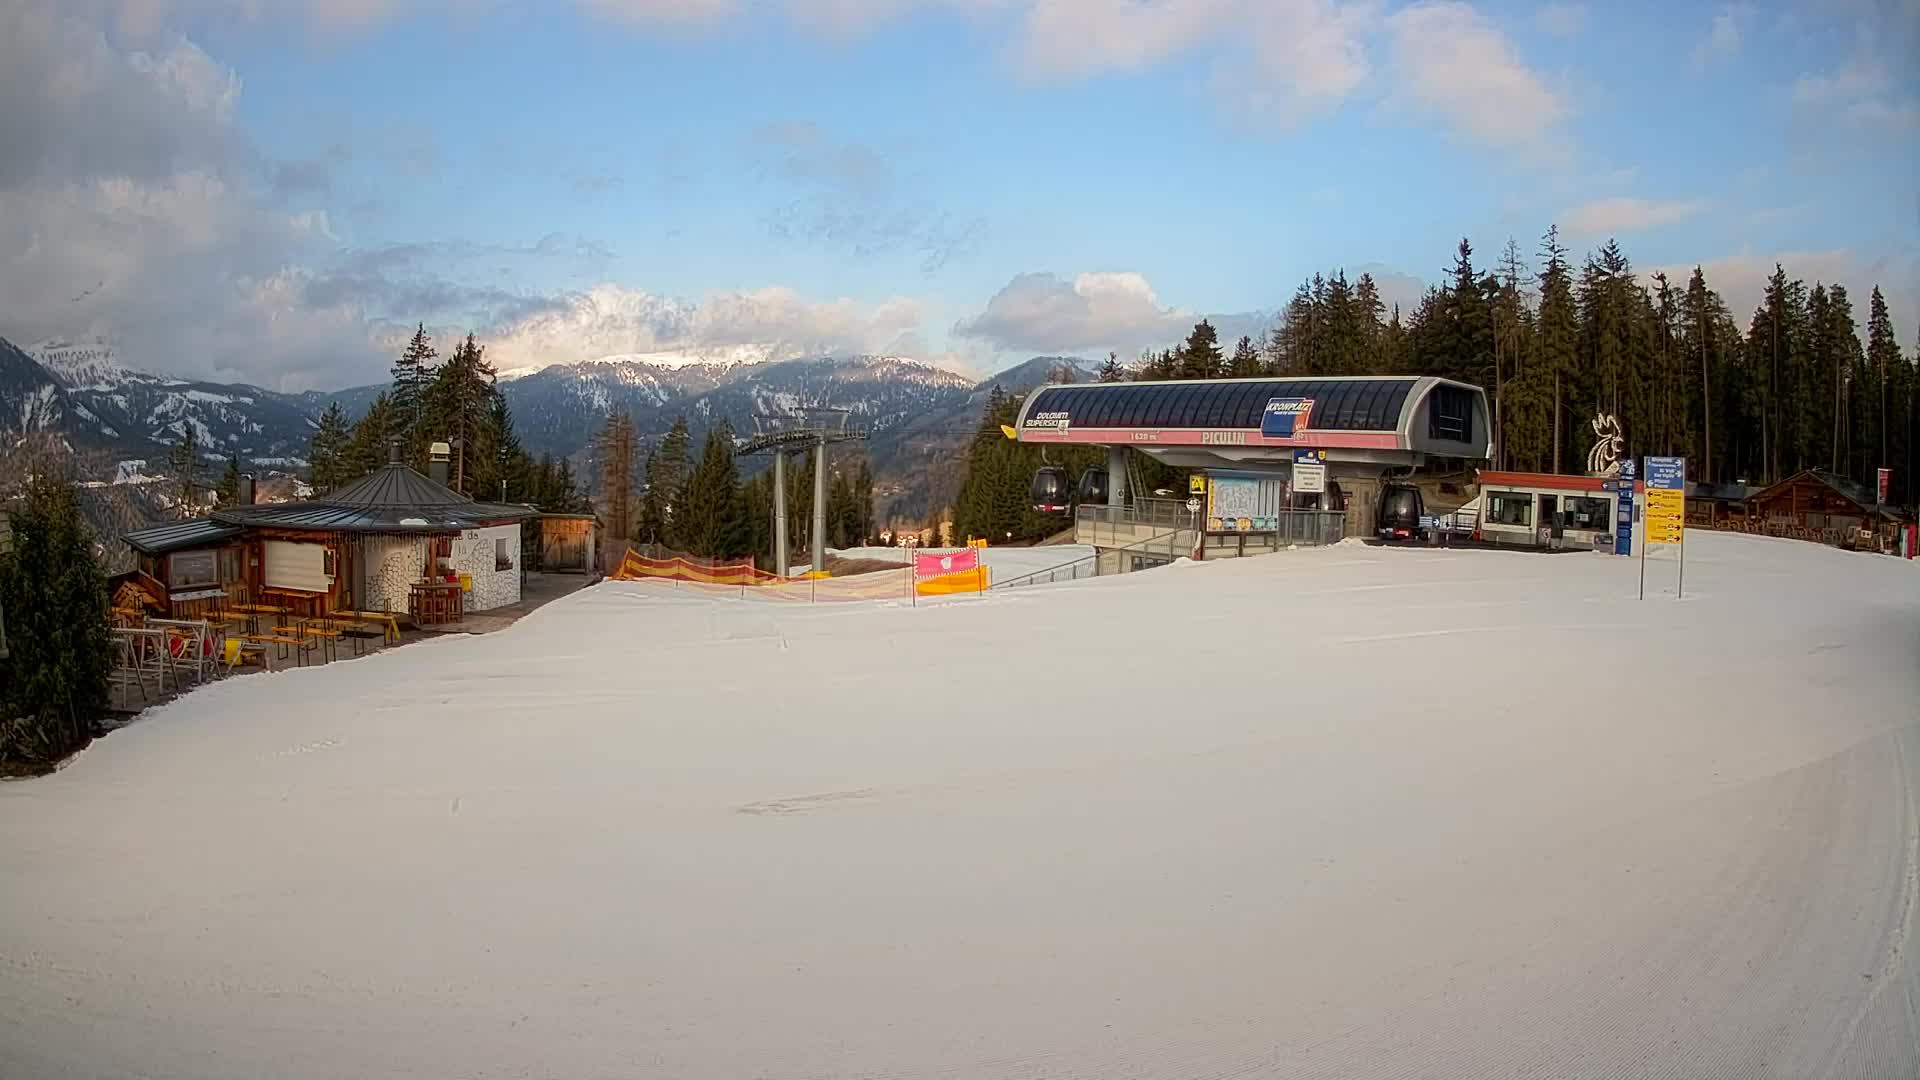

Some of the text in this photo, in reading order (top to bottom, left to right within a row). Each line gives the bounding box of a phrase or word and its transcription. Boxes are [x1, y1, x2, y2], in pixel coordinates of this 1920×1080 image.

[1266, 402, 1311, 411] KRONPLATZ
[1025, 419, 1059, 427] SUPERSKI
[1202, 431, 1245, 445] PICULIN
